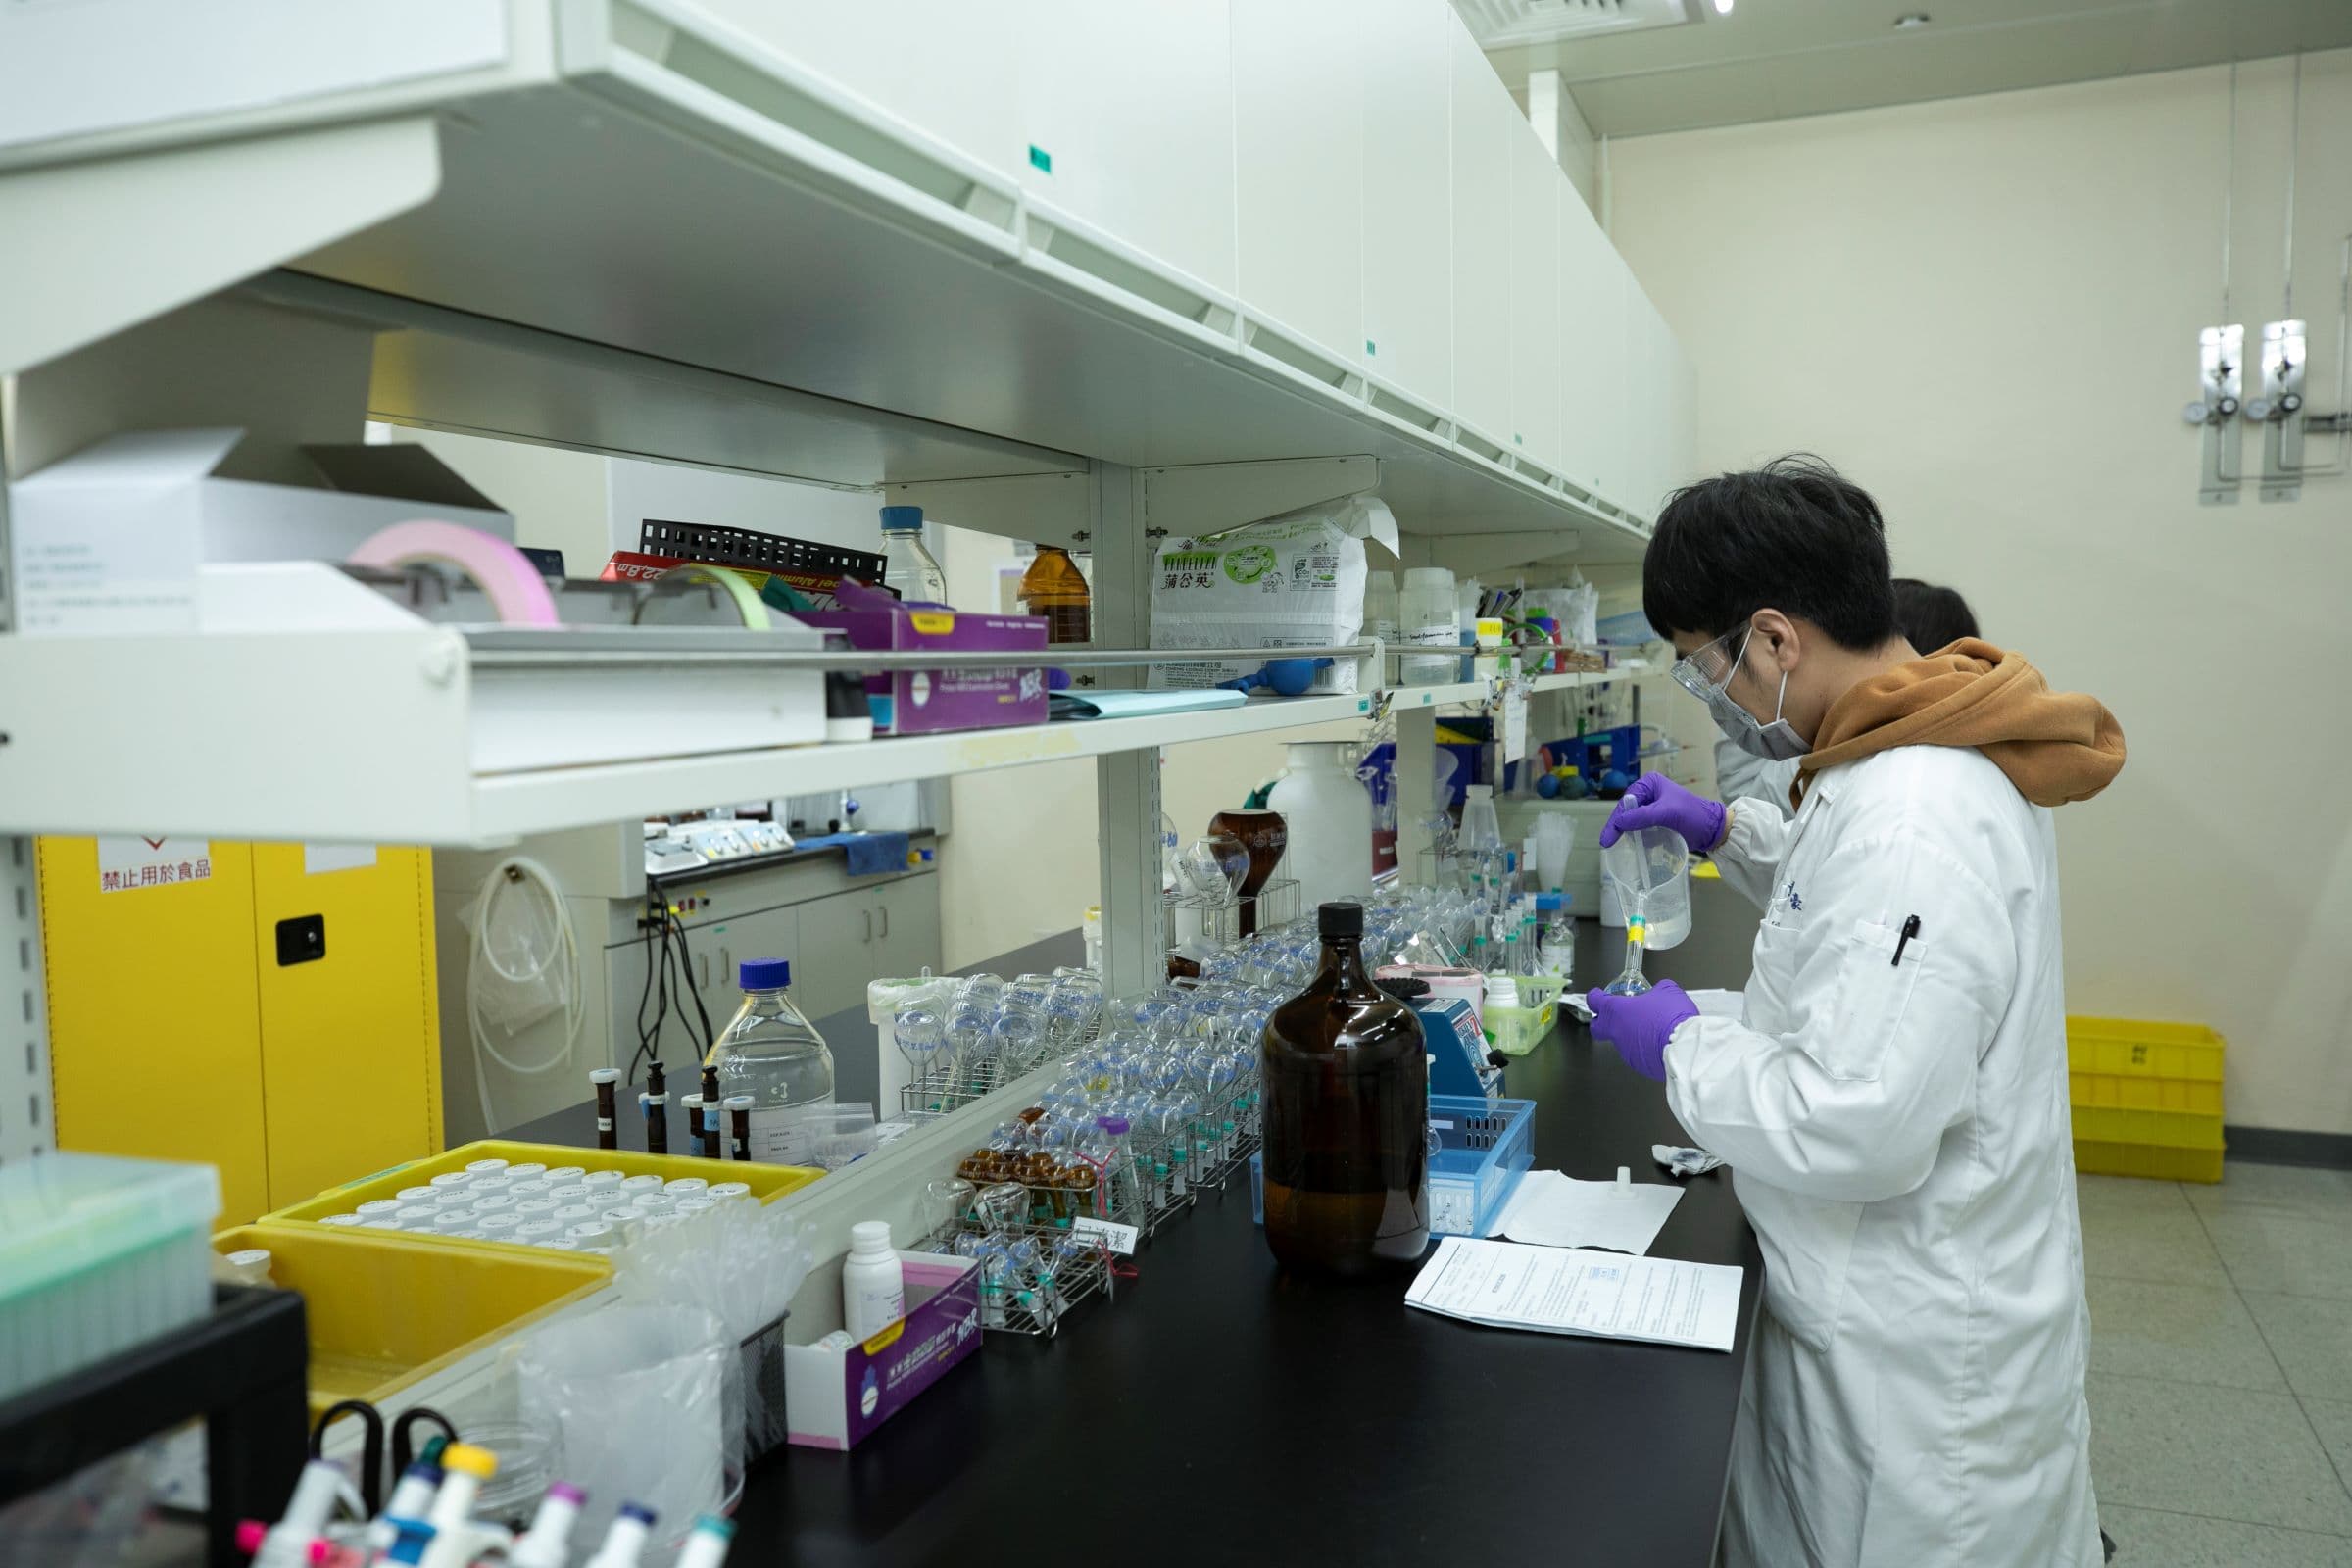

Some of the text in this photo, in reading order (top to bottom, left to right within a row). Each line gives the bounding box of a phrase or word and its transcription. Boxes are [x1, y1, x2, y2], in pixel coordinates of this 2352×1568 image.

[1160, 571, 1212, 589] 蒲公英
[102, 858, 211, 891] 禁止用於食品
